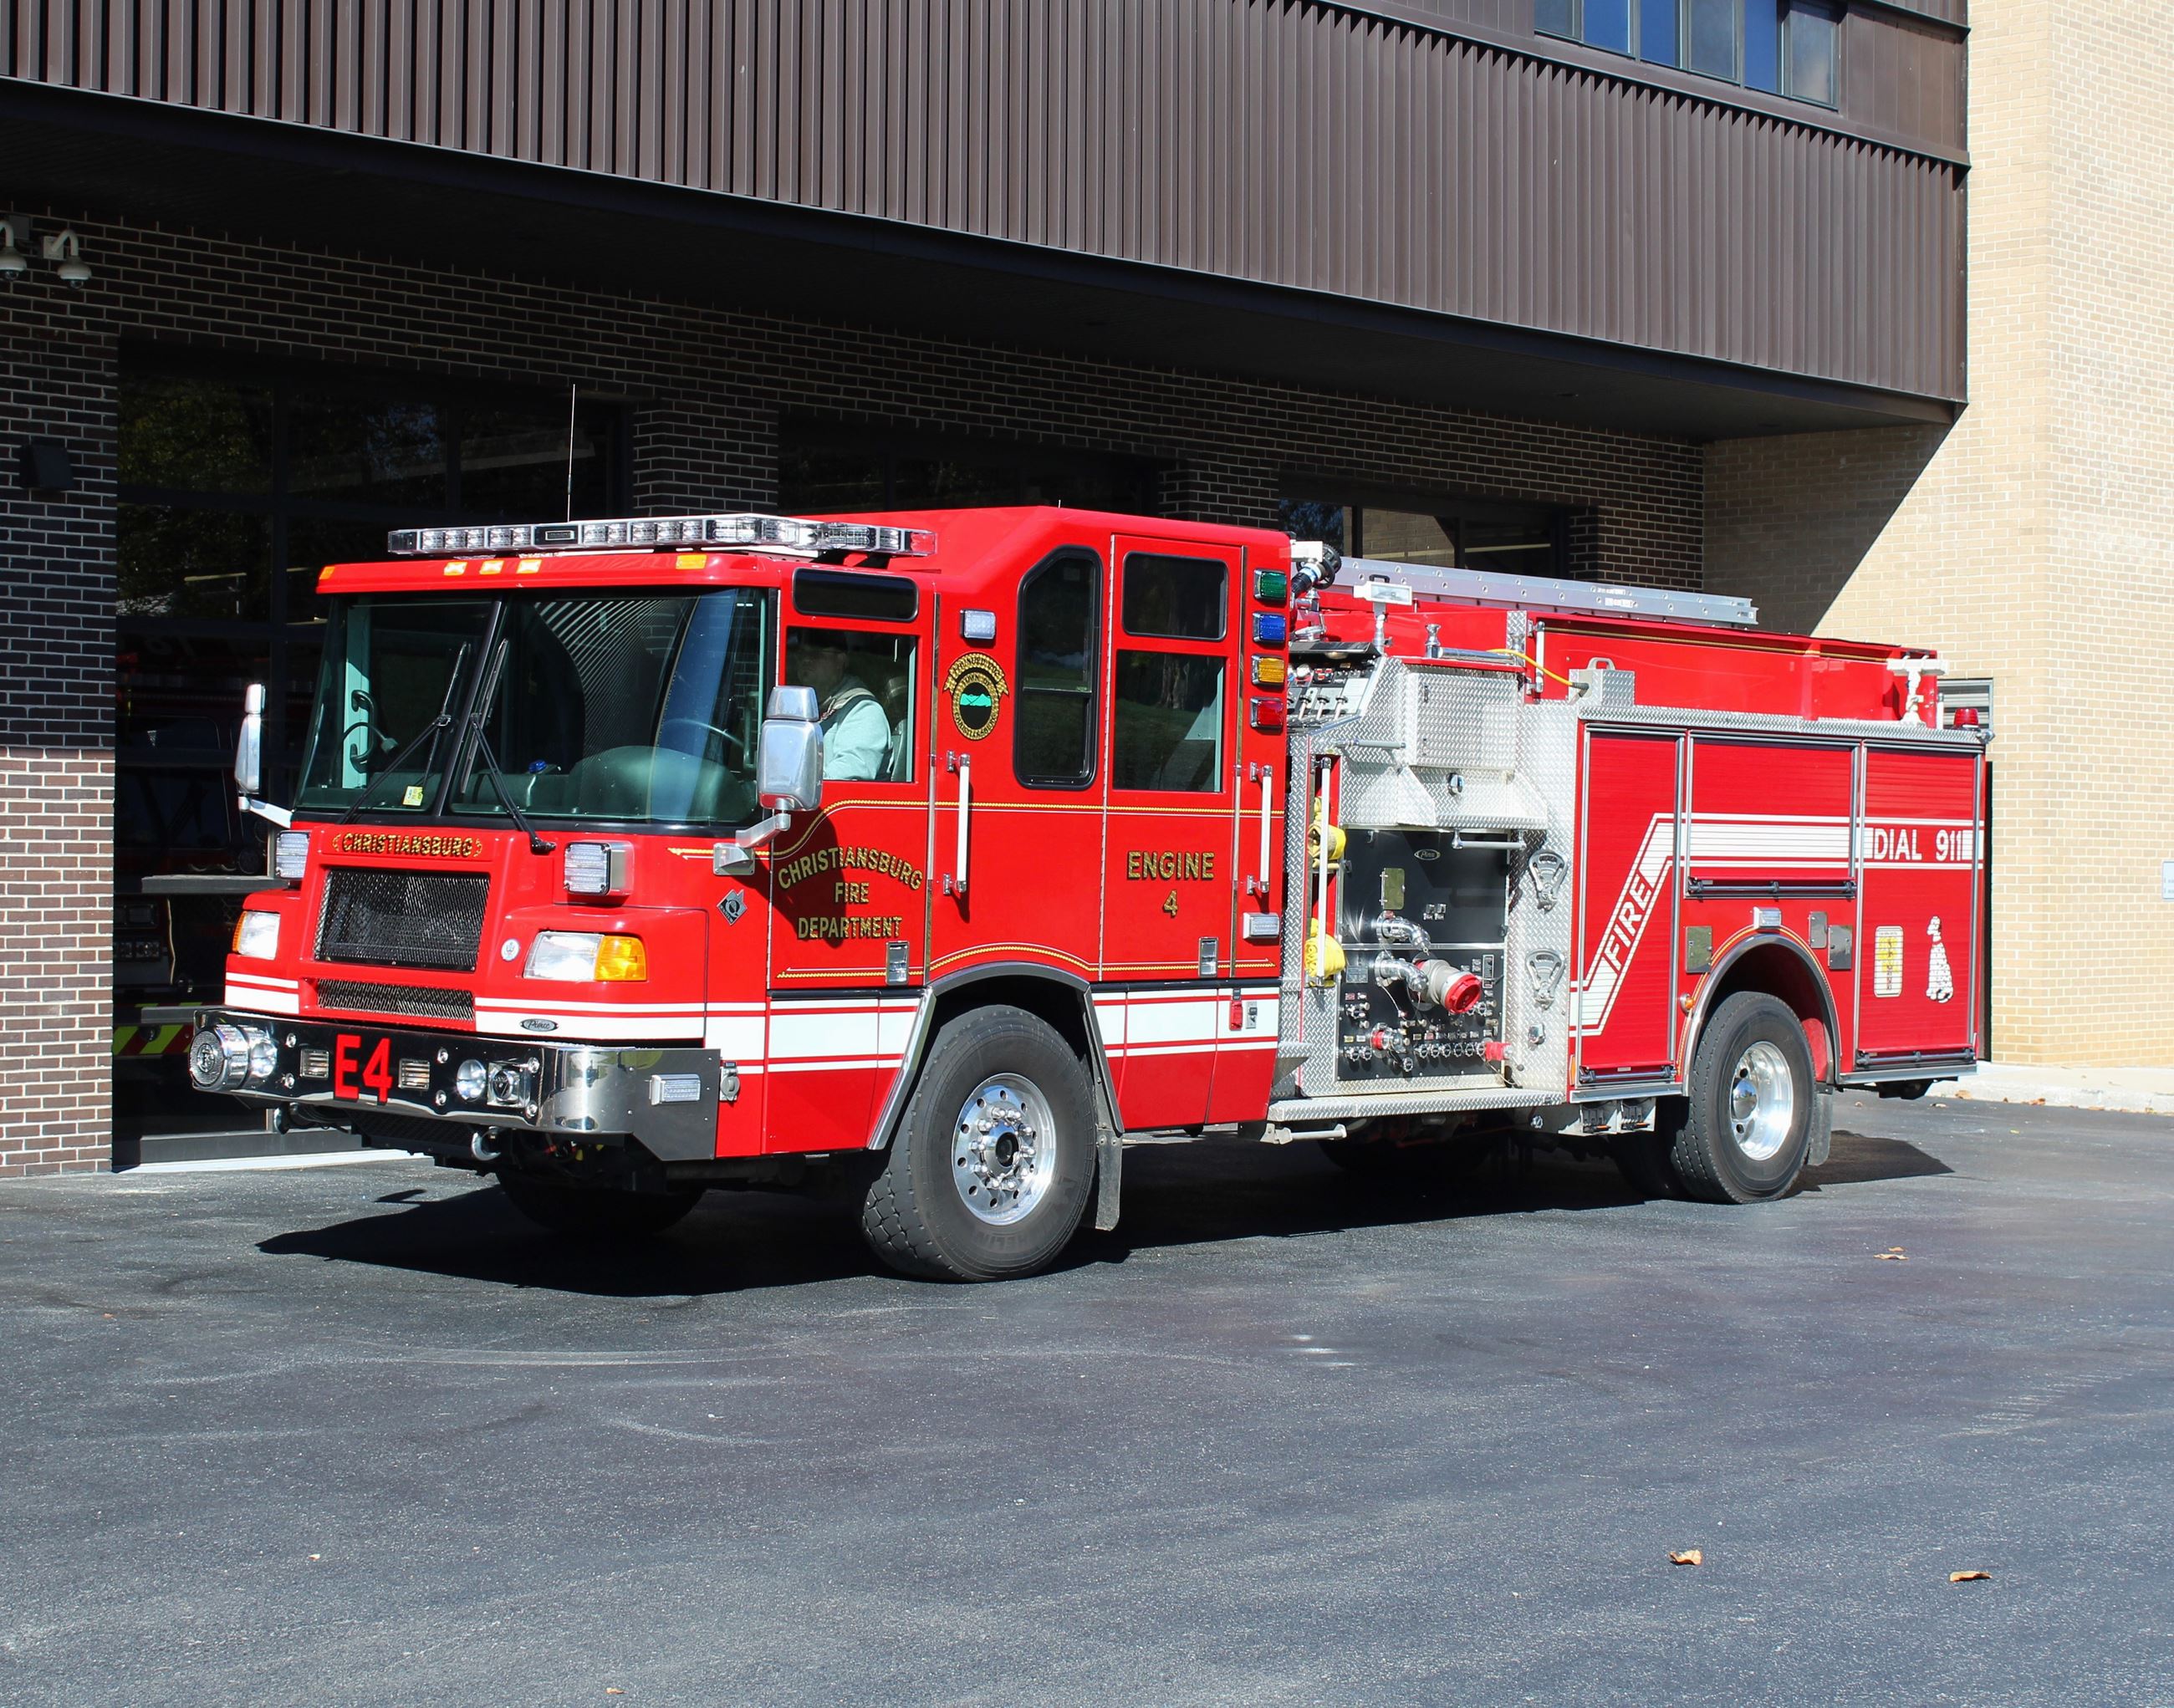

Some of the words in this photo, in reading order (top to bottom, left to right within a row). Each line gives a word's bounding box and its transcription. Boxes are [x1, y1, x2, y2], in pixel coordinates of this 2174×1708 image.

[342, 833, 473, 858] CHRISTIANSBURG
[1873, 828, 1922, 861] DIAL
[1936, 829, 1962, 862] 911
[778, 846, 923, 890] CHRISTIANSBURG
[1127, 851, 1215, 879] ENGINE
[834, 882, 870, 904] FIRE
[1162, 890, 1178, 916] 4
[798, 916, 902, 939] DEPARTMENT
[1604, 874, 1652, 971] FIRE
[335, 1033, 393, 1103] E4
